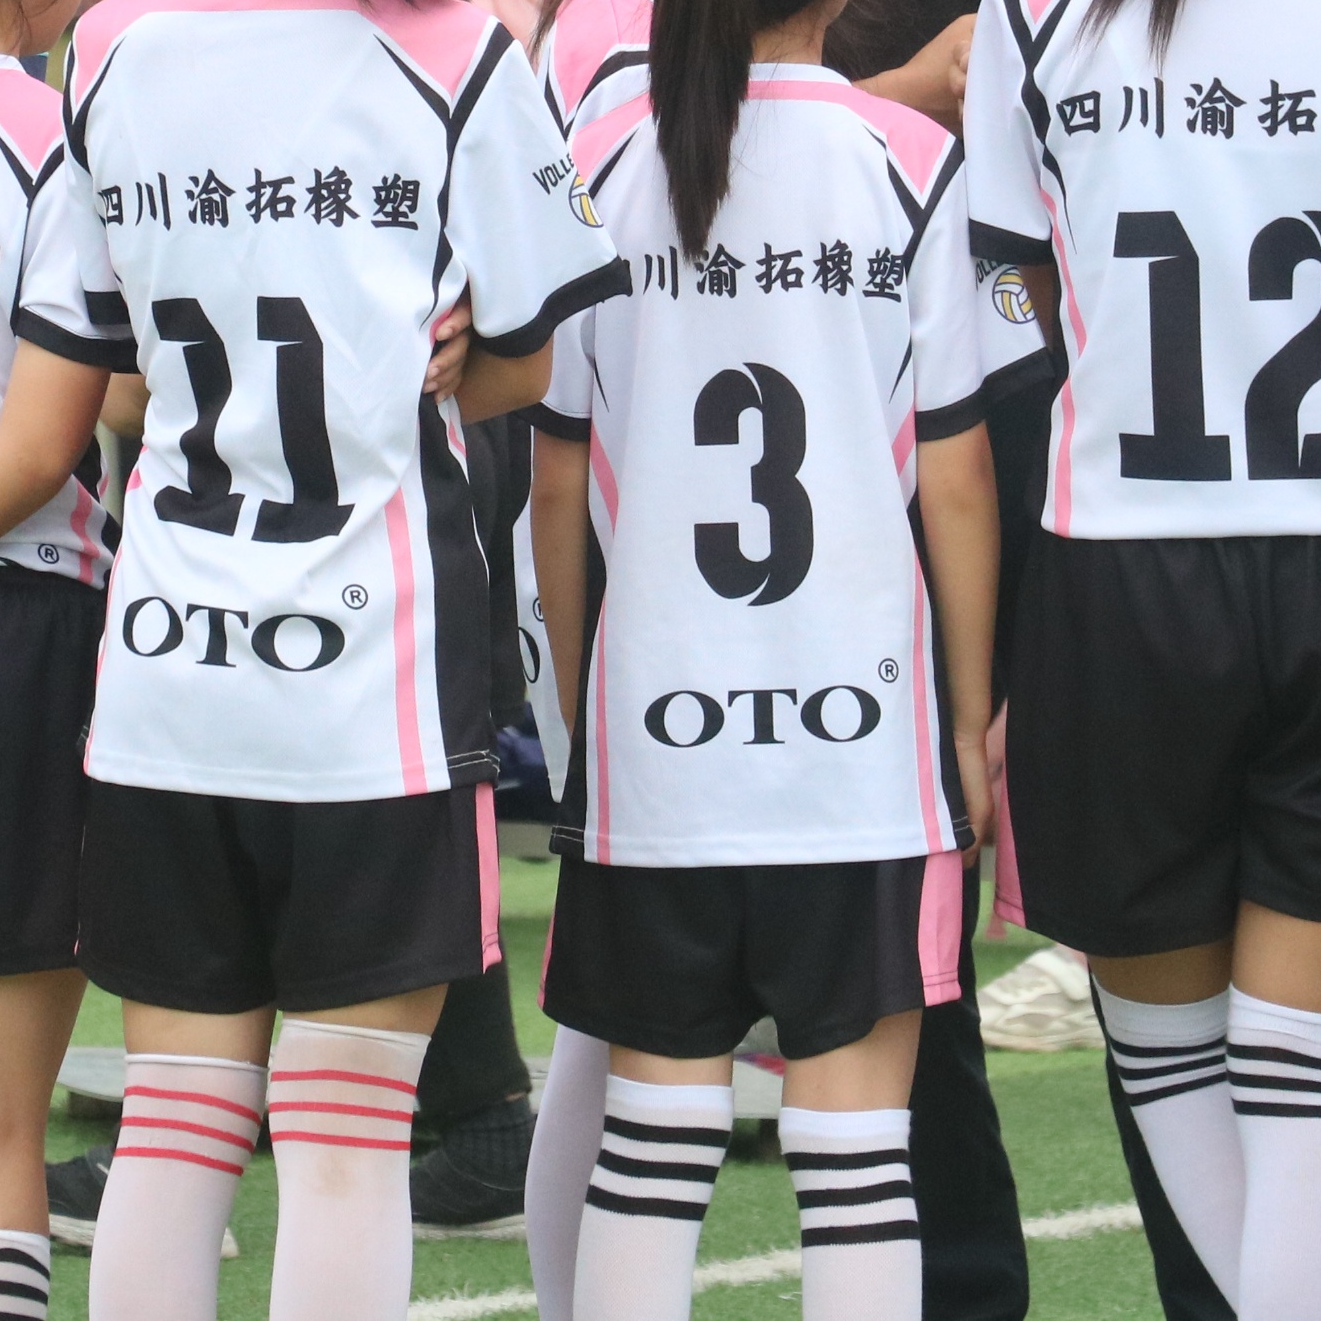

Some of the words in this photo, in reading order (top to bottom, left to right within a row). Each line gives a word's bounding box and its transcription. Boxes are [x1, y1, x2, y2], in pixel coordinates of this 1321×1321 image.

[99, 167, 421, 231] 四川渝拓橡塑
[602, 239, 907, 303] 川渝拓橡塑
[152, 297, 355, 543] 11
[694, 363, 813, 606] 3
